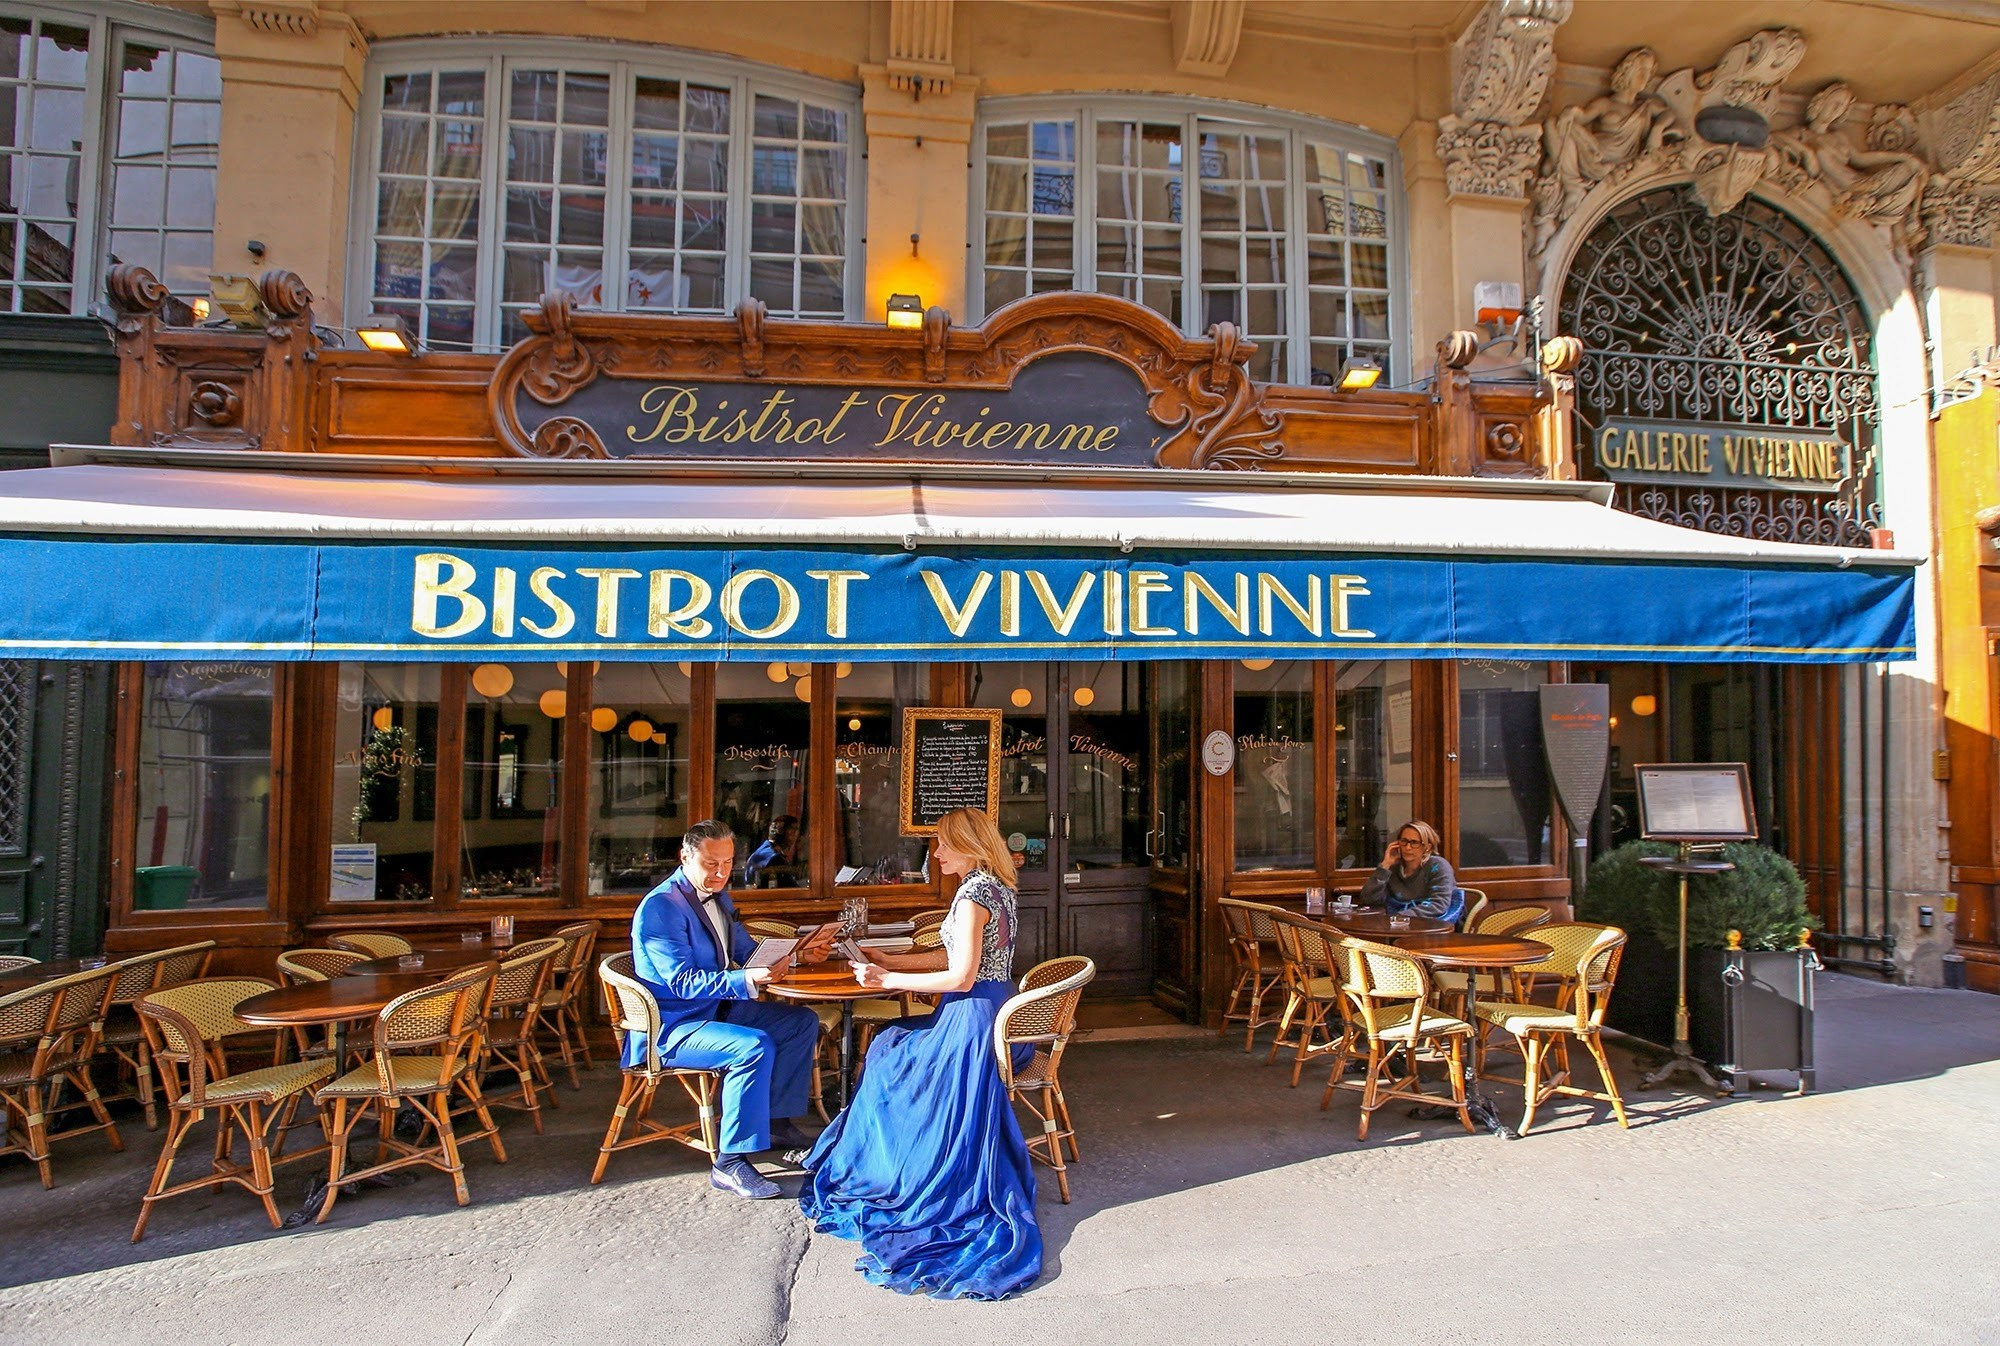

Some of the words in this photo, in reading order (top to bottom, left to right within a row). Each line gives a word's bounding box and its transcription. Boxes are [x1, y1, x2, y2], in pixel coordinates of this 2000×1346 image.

[626, 385, 869, 445] Bistrot
[874, 392, 1120, 452] Vivienne
[1600, 427, 1713, 474] GALERIE
[1723, 435, 1842, 480] VIVIENNE
[411, 552, 870, 639] BISTROT
[920, 569, 1377, 639] VIVIENNE
[724, 744, 791, 763] Digestifs
[1000, 736, 1046, 757] istrot
[1070, 735, 1137, 771] Vivienne
[1237, 733, 1266, 751] Plat
[1268, 738, 1281, 747] du
[1281, 735, 1306, 752] Jour
